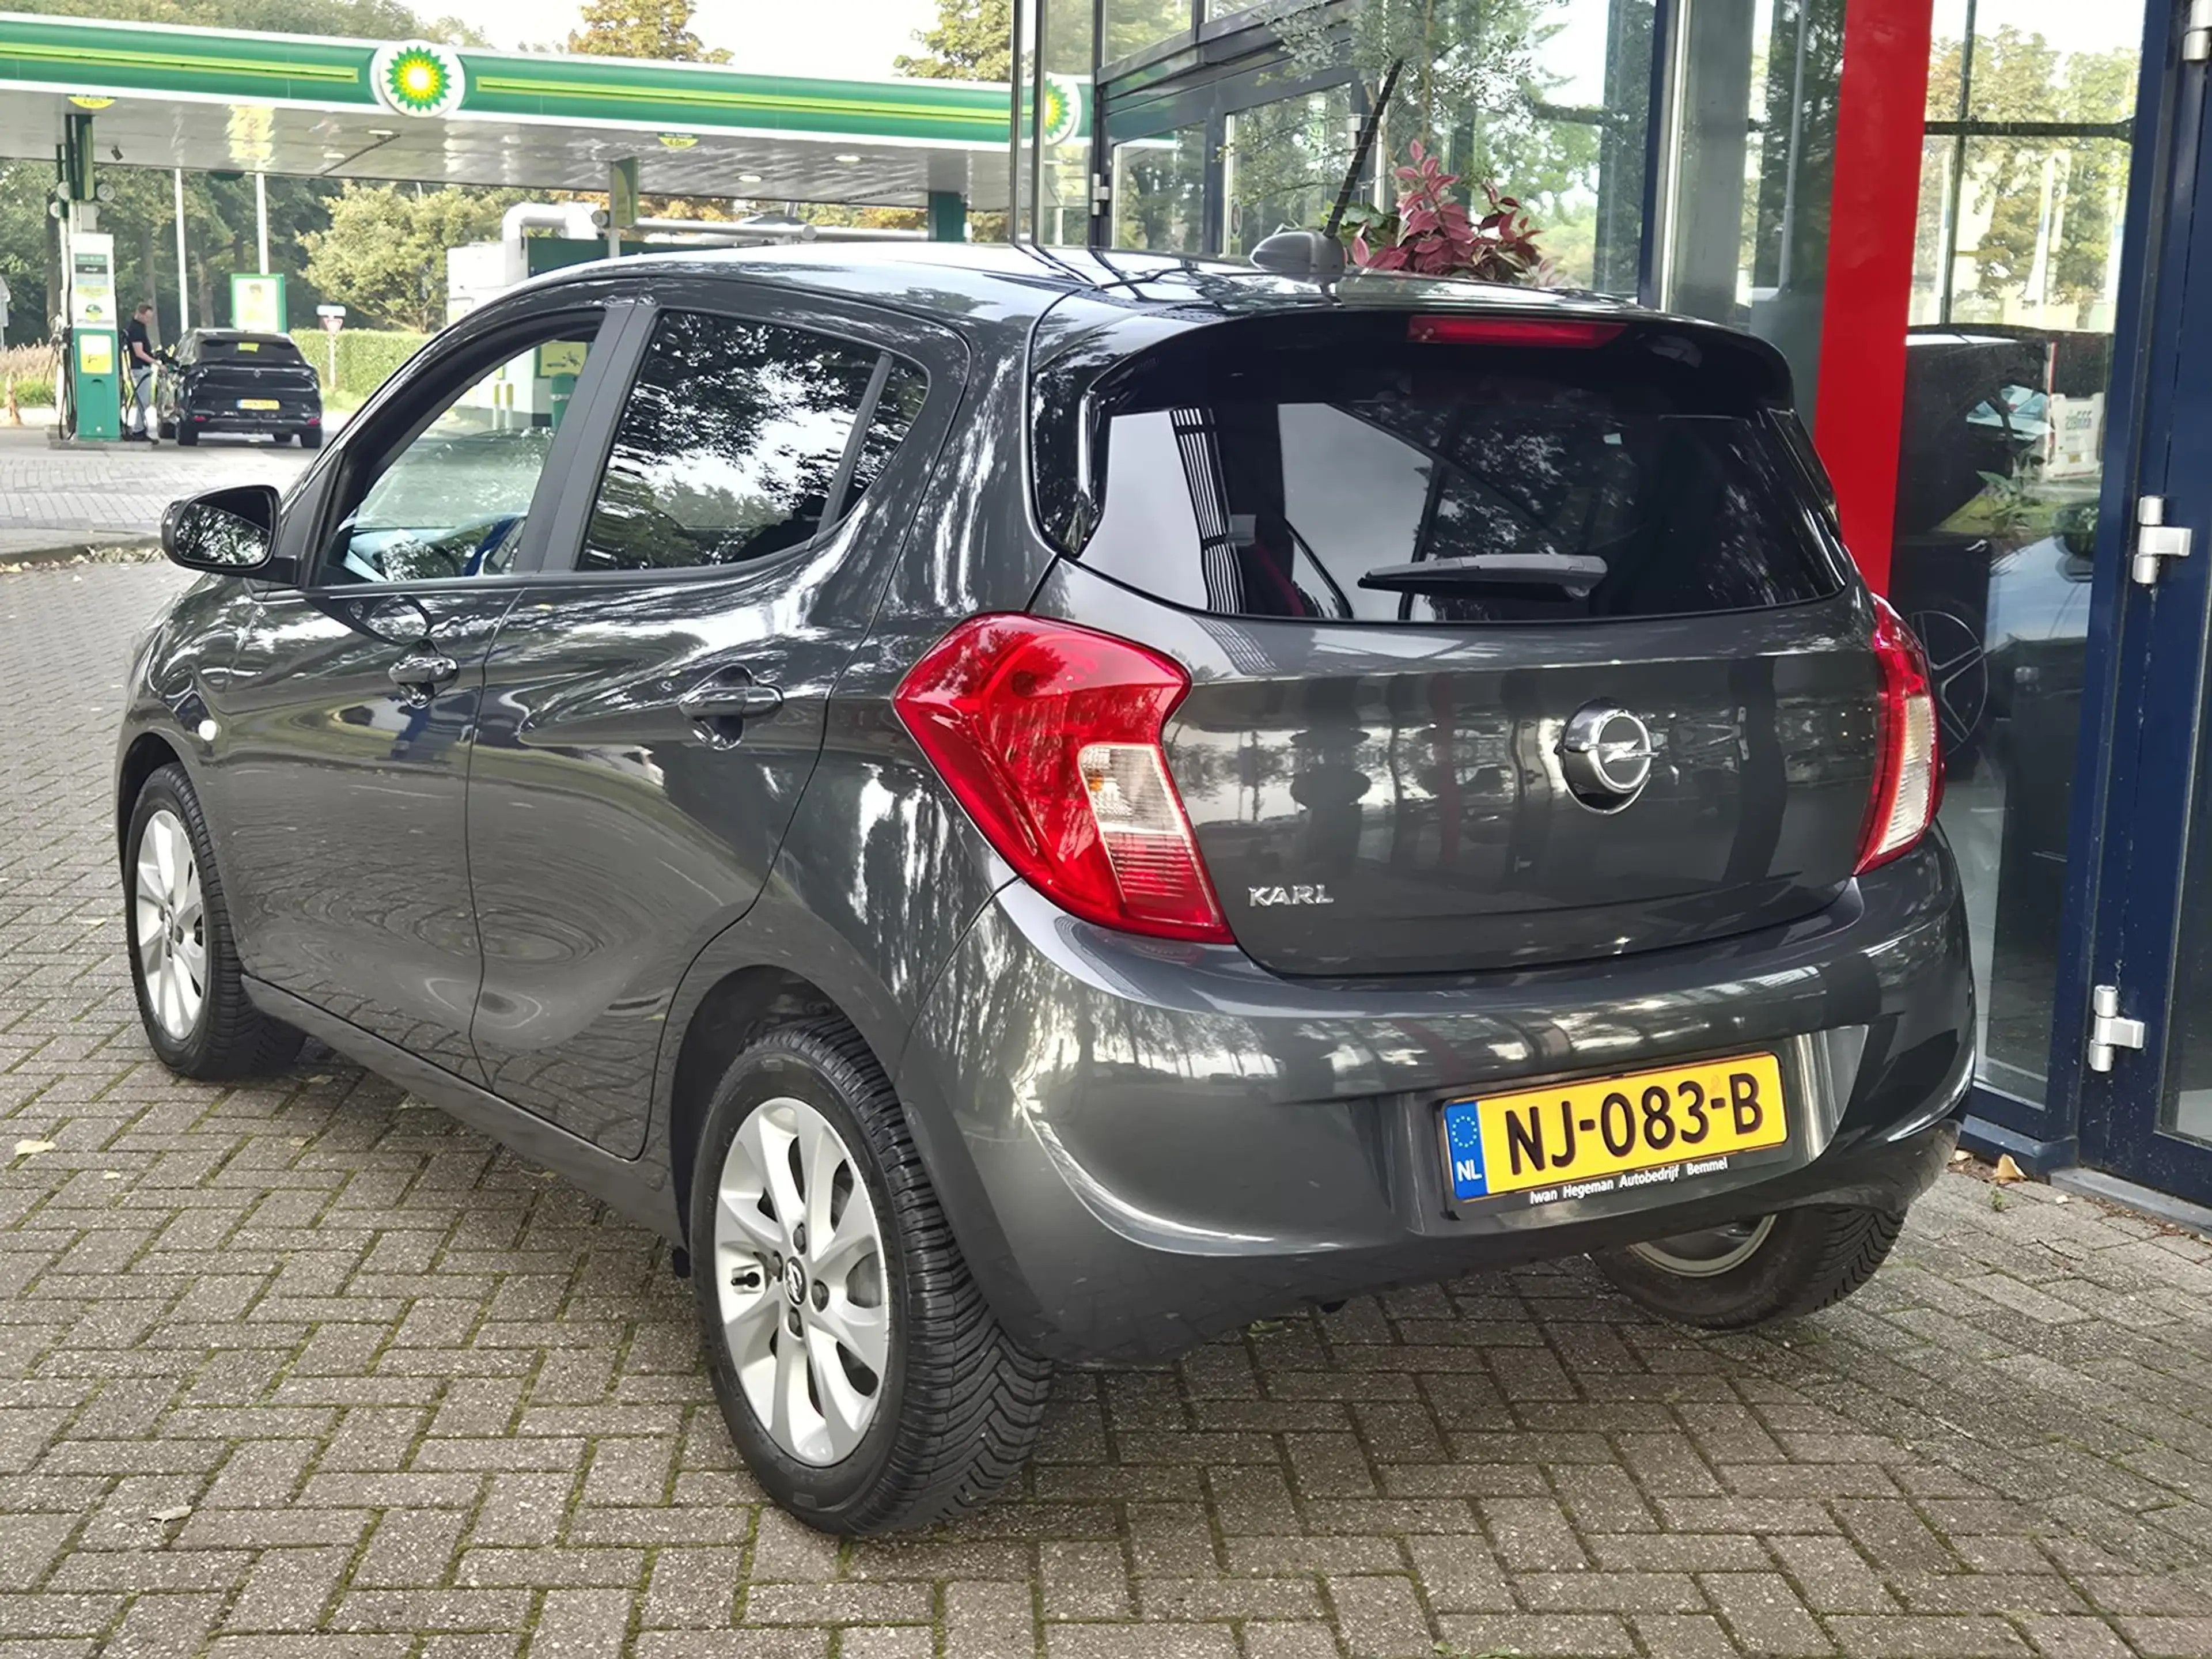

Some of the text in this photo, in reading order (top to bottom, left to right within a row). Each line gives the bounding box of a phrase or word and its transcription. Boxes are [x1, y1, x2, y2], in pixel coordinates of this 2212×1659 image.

[1248, 884, 1334, 907] KARL
[1505, 1073, 1763, 1176] NJ-083-B
[1456, 1158, 1483, 1182] NL
[1529, 1156, 1729, 1205] Iwan Hegeman Autobedrijf Bemmel
